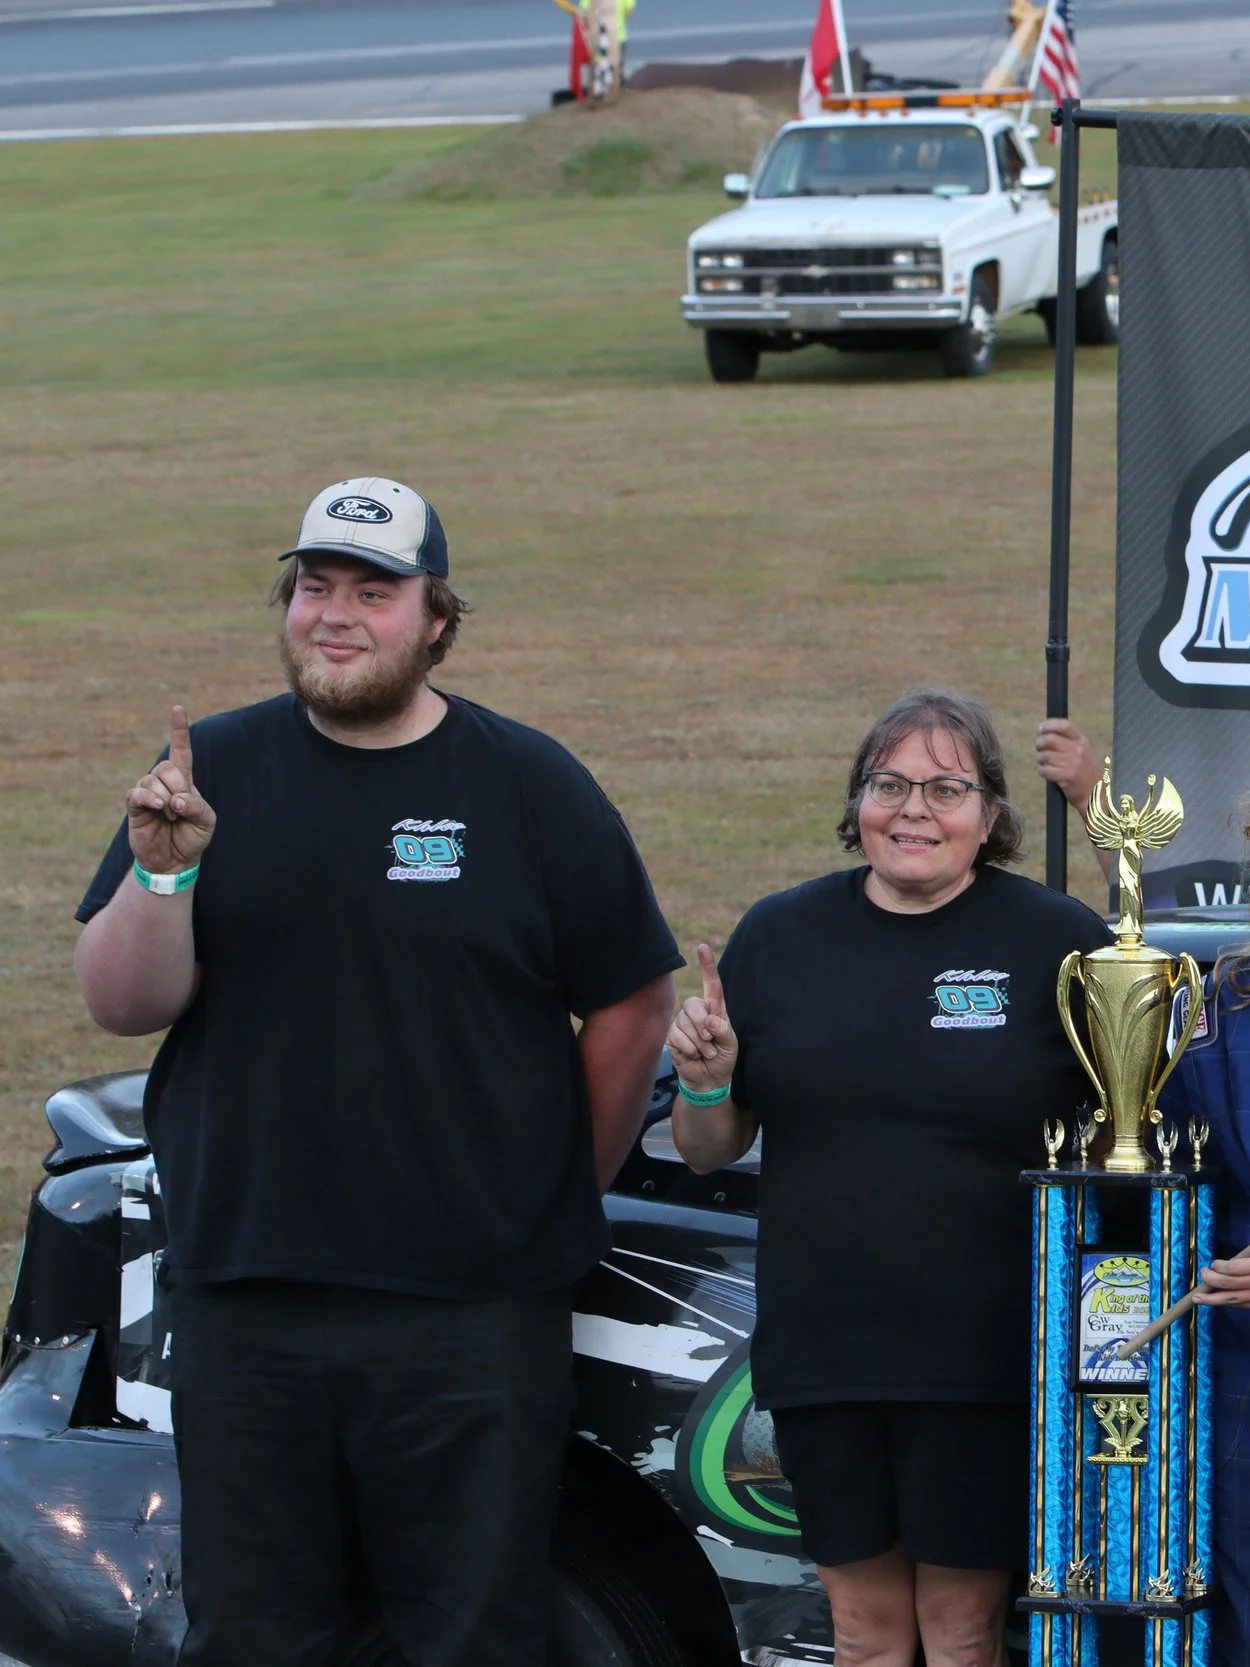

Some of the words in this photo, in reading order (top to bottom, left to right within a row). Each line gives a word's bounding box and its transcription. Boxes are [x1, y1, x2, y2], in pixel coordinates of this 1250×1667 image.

[336, 498, 379, 520] Ford
[392, 834, 458, 865] 09
[386, 866, 461, 880] Goodbout
[935, 985, 1003, 1014] 09
[930, 1013, 1007, 1029] Goodbout
[1090, 1320, 1123, 1334] Gray
[1081, 1367, 1149, 1381] WINNE
